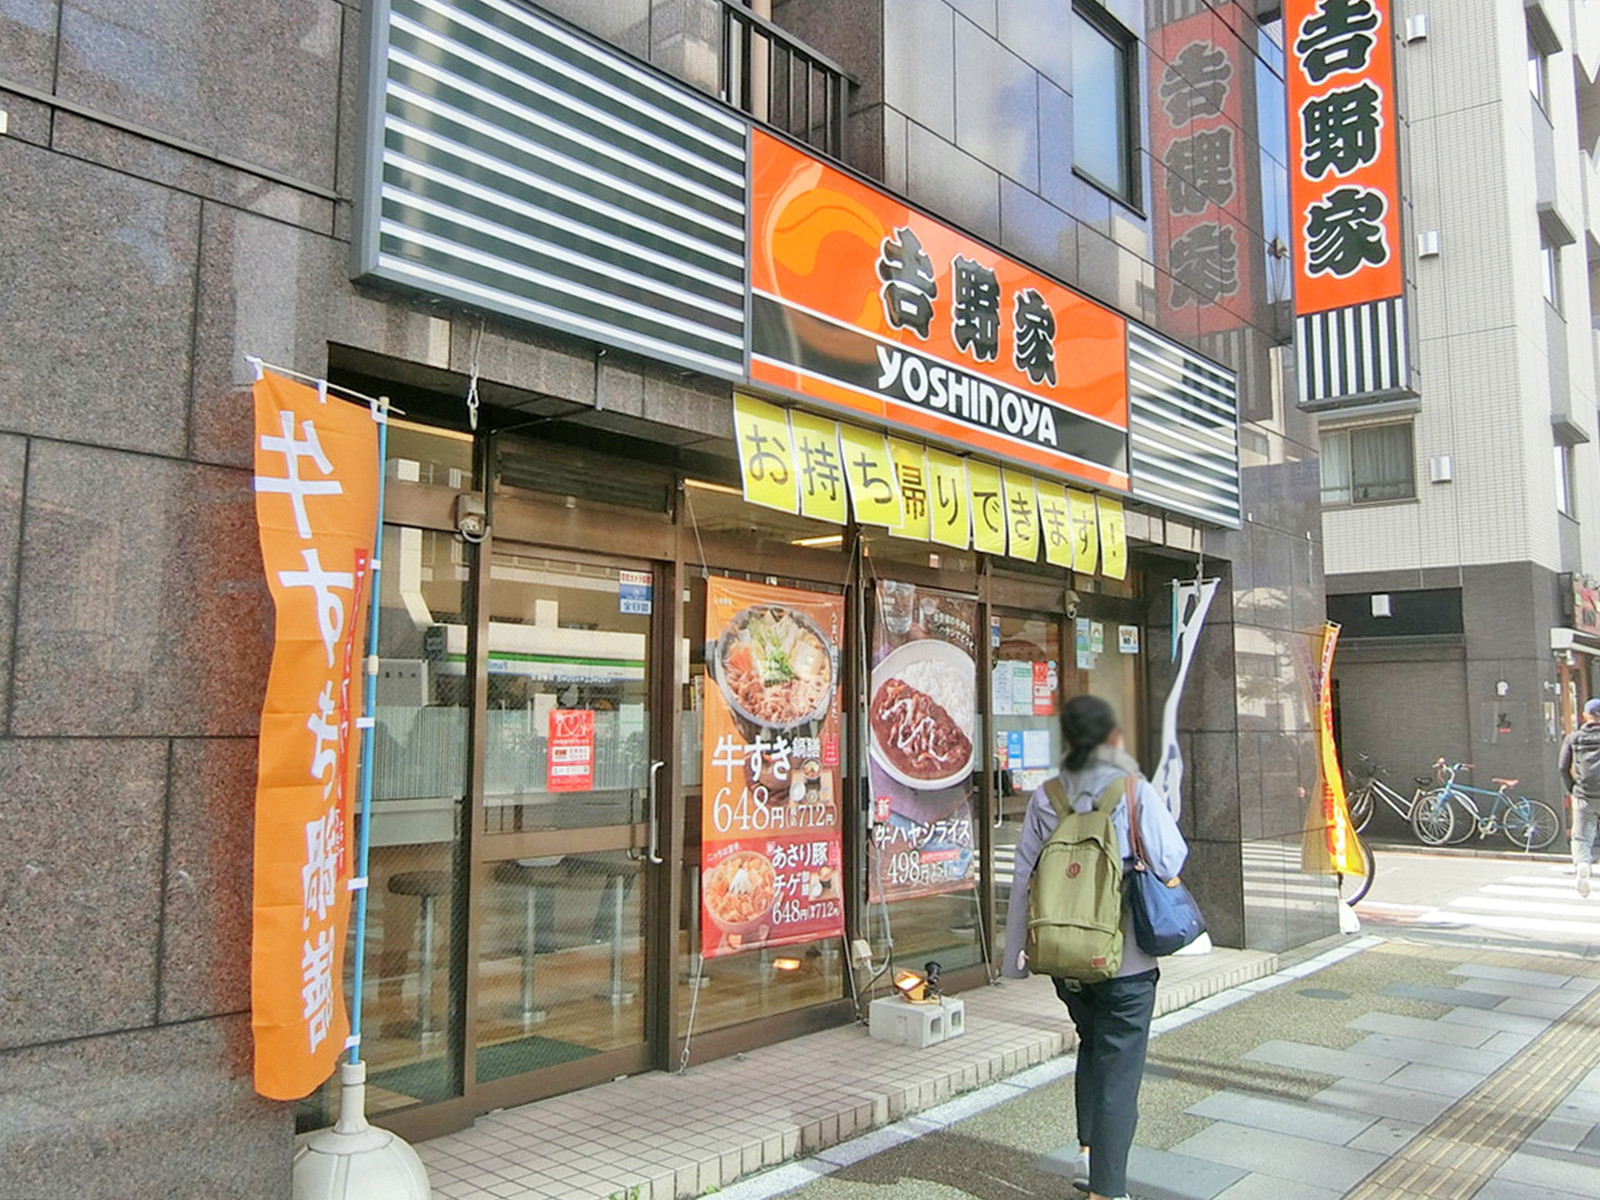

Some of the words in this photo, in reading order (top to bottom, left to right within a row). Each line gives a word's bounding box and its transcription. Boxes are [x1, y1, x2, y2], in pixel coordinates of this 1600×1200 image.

[1296, 0, 1391, 279] 吉野家
[876, 225, 1058, 388] 吉野家
[876, 345, 1058, 447] YOSHINOYA
